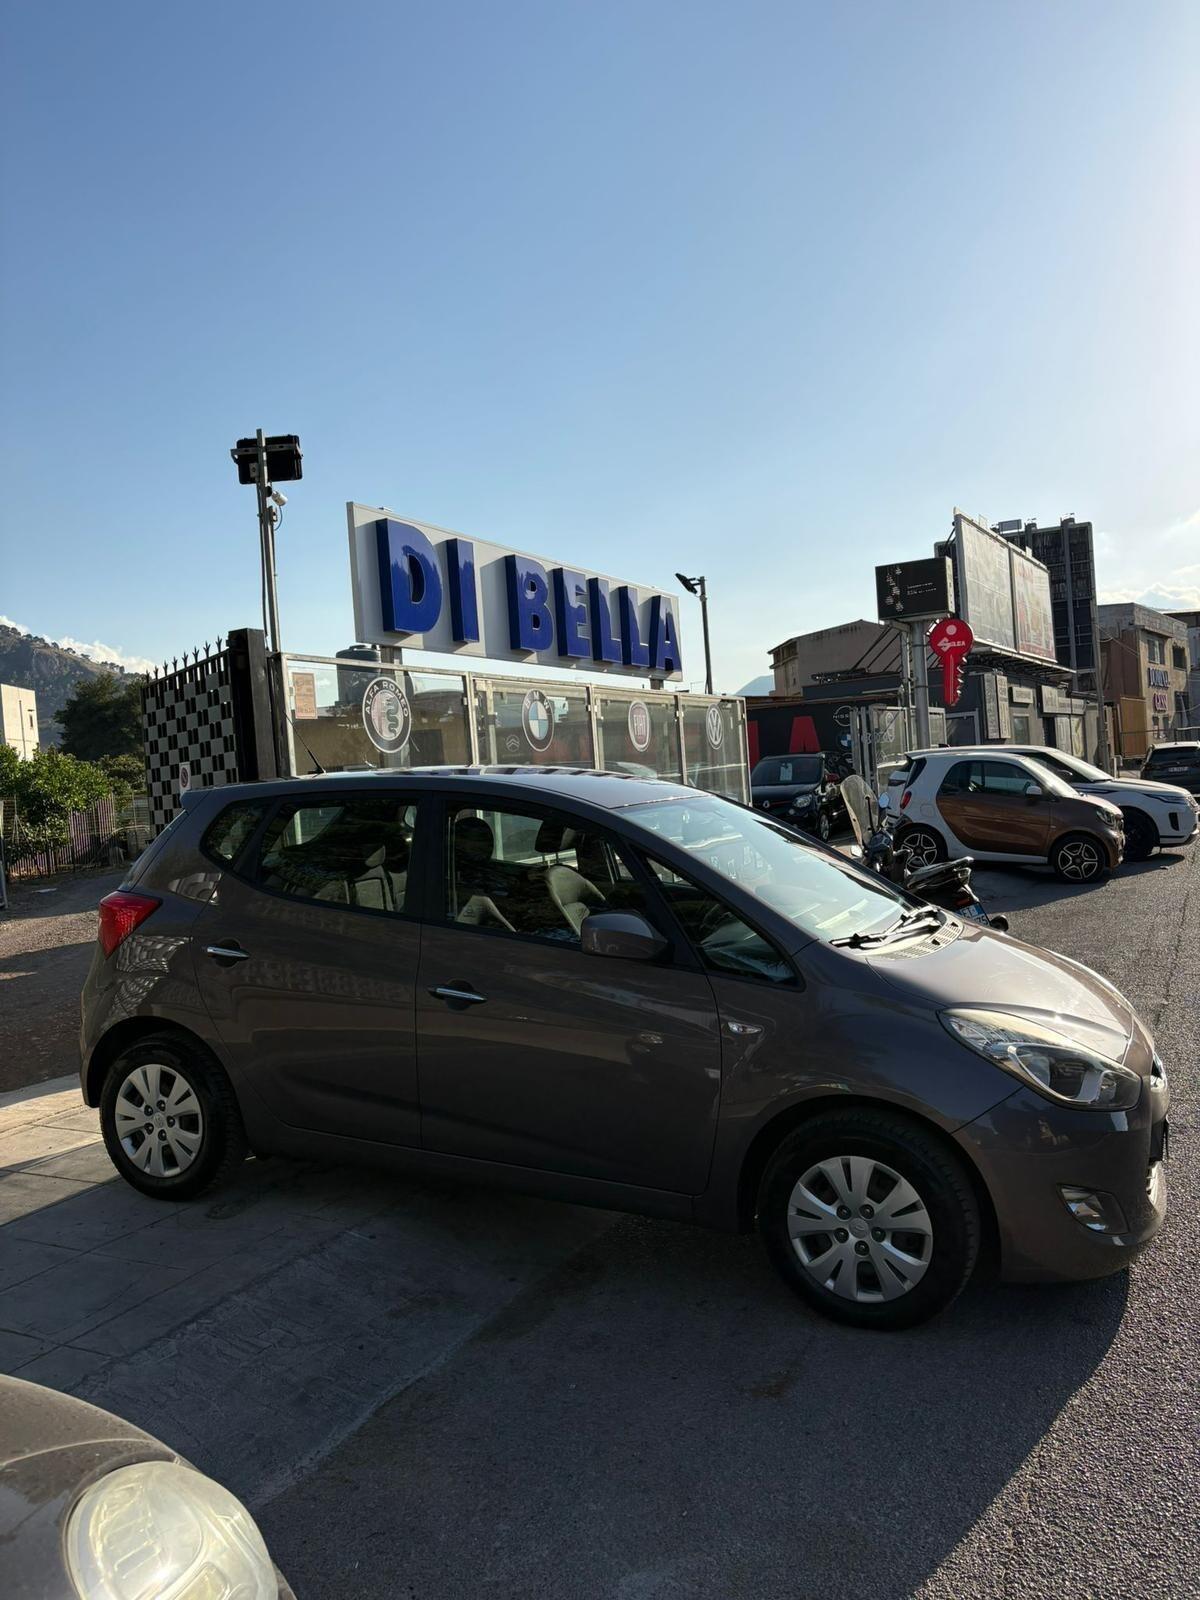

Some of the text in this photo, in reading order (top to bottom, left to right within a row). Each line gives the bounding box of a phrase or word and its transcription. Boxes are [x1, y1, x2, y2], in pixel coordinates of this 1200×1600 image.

[376, 518, 682, 671] DI BELLA
[364, 681, 409, 717] ALFA ROMEO
[524, 691, 550, 710] BMW
